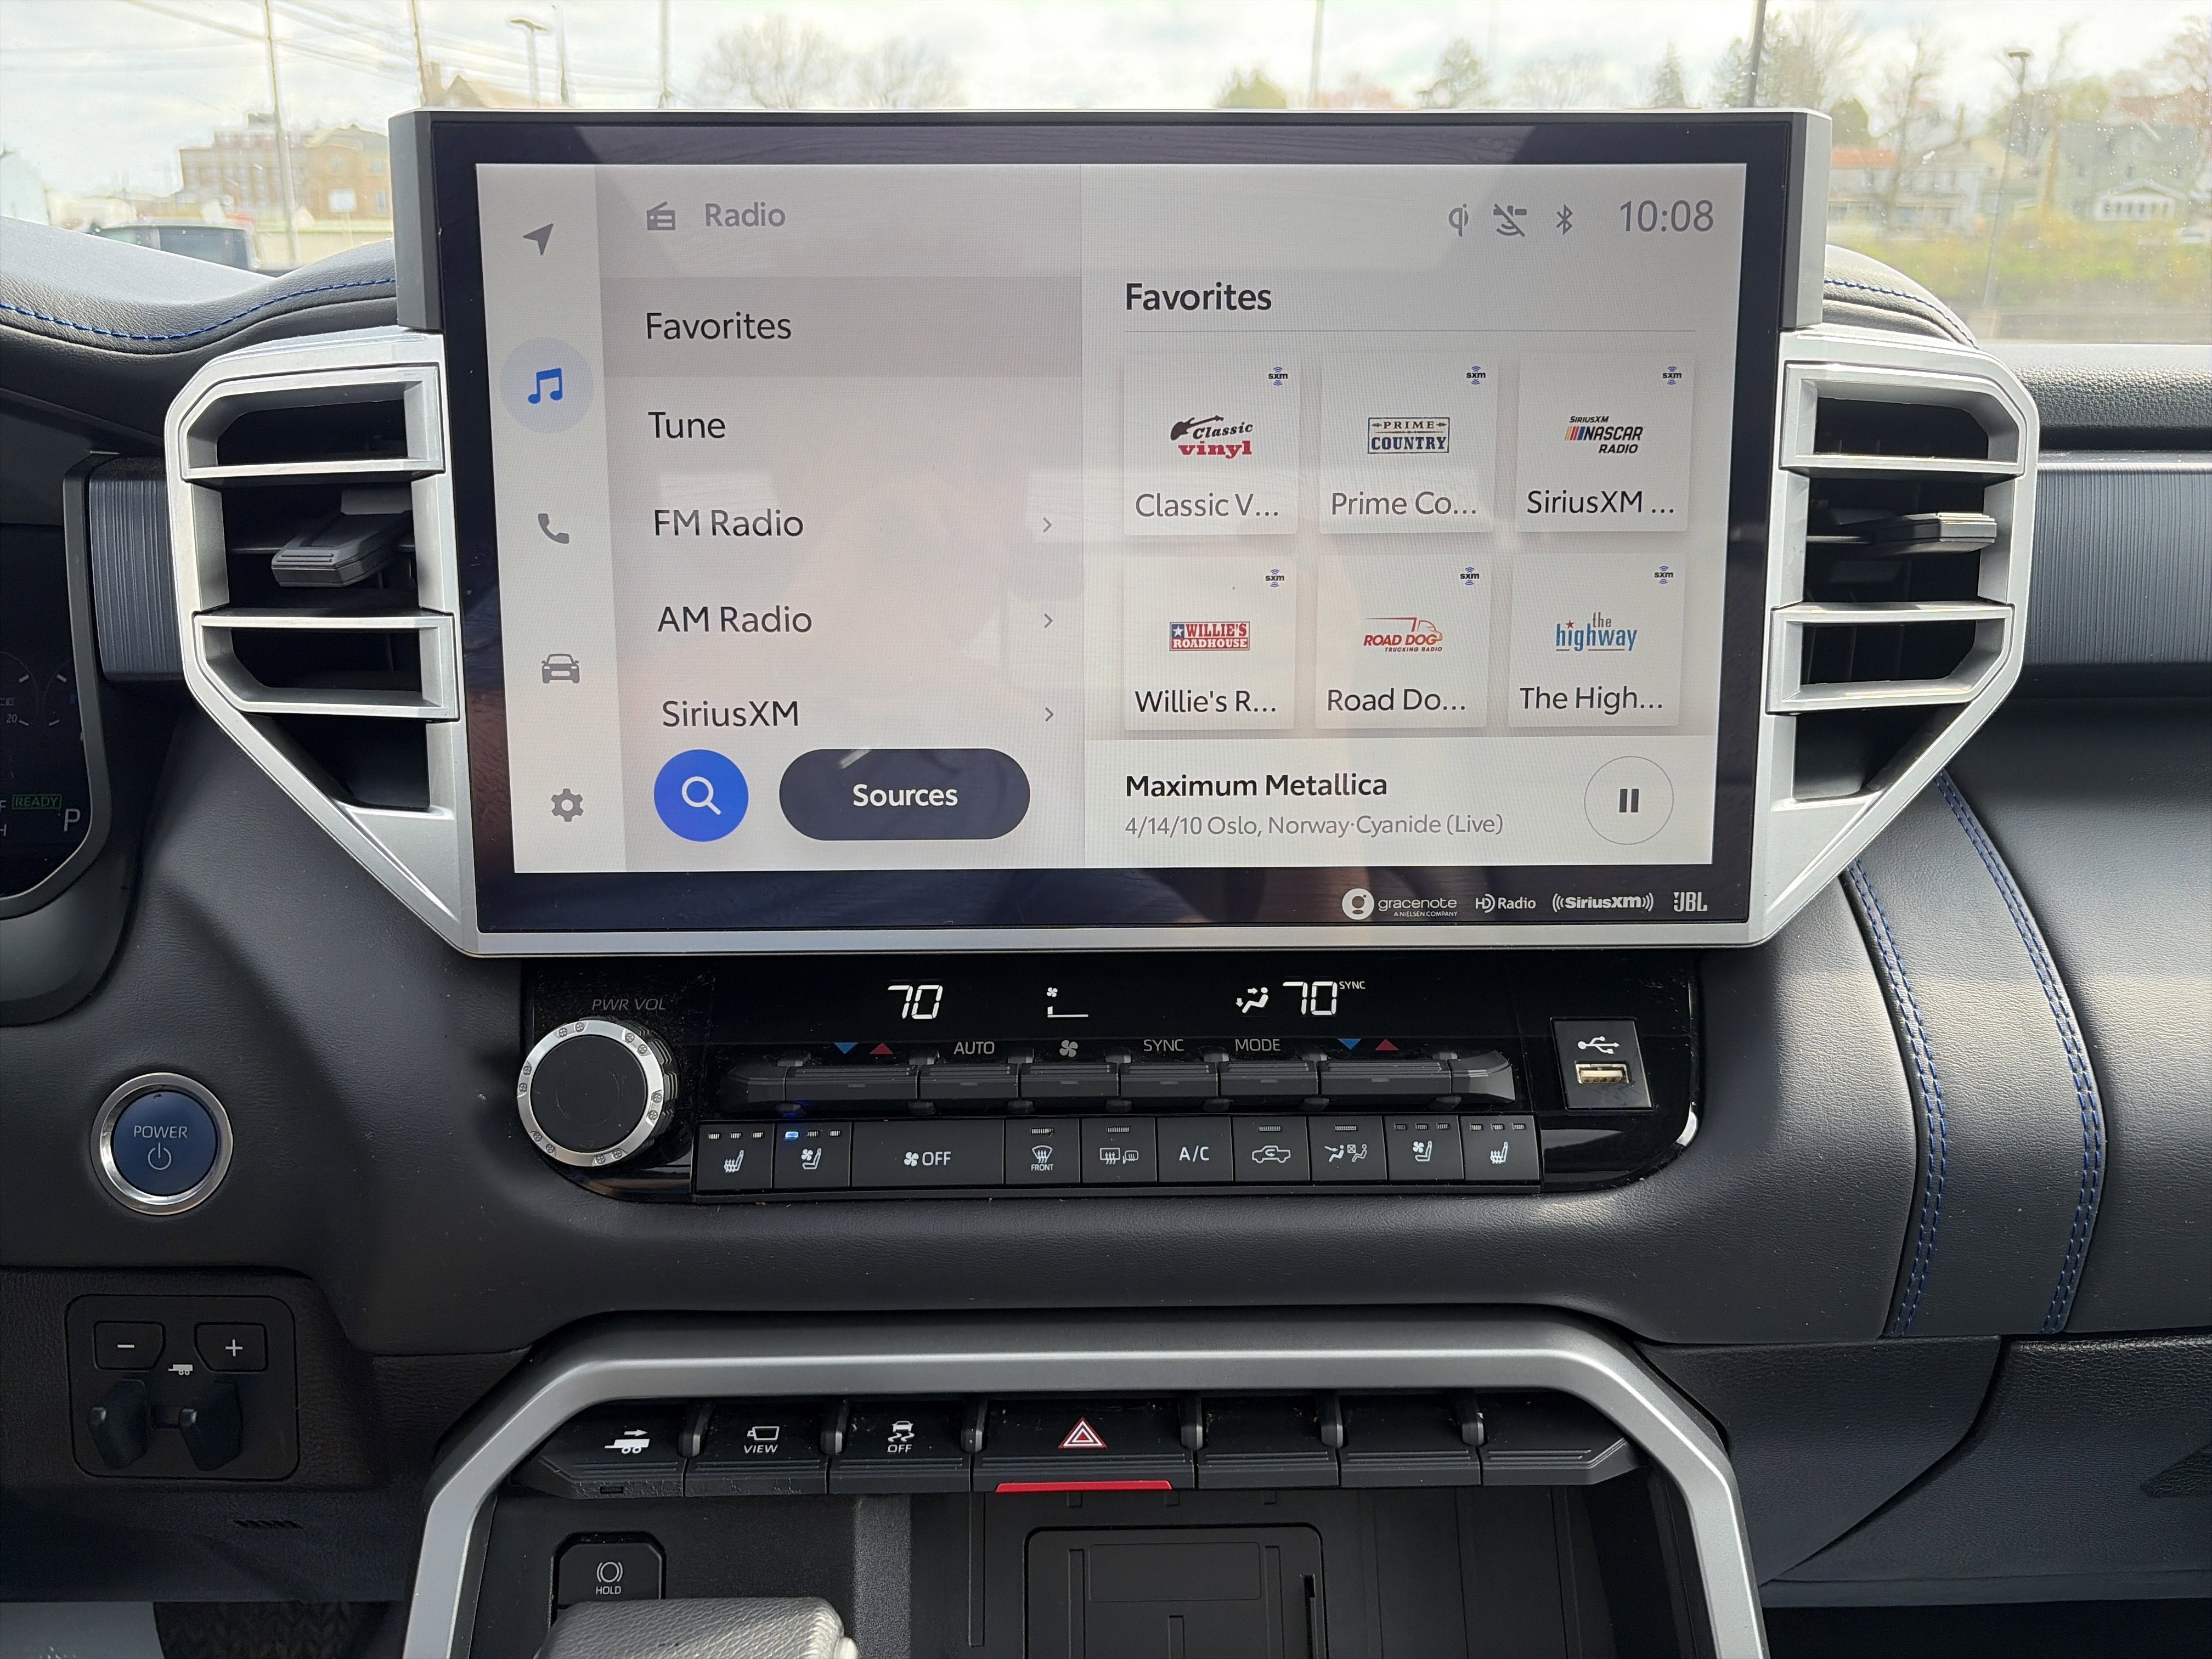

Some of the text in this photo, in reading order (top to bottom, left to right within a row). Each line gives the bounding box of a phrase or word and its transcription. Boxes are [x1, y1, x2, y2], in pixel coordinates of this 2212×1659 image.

[705, 201, 786, 227] Radio
[1620, 200, 1714, 232] 10:08
[1126, 281, 1272, 311] Favorites
[646, 311, 792, 340] Favorites
[647, 411, 726, 439] Tune
[1193, 421, 1253, 439] Classic
[1383, 420, 1435, 430] PRIME
[1583, 426, 1644, 441] NASCAR
[1178, 441, 1252, 459] vinyl
[1372, 436, 1447, 450] COUNTRY
[1598, 444, 1639, 454] RADIO
[1136, 492, 1278, 517] Classic V...
[1332, 491, 1476, 515] Prime Co...
[1527, 489, 1643, 514] SiriusXM
[654, 509, 803, 537] FM Radio
[657, 605, 812, 633] AM Radio
[1592, 611, 1612, 628] the
[1173, 639, 1247, 648] ROADHOUSE
[1363, 634, 1437, 646] ROAD DOG
[1556, 623, 1638, 651] highway
[1135, 689, 1276, 713] Willie's R...
[1328, 687, 1465, 712] Road Do...
[1519, 685, 1662, 715] The High...
[663, 700, 798, 727] SiriusXM
[853, 783, 958, 806] Sources
[1126, 772, 1387, 797] Maximum Metallica
[15, 796, 59, 807] READY
[64, 808, 81, 832] P
[1125, 816, 1202, 838] 4/14/10
[1207, 815, 1262, 837] Oslo,
[1447, 814, 1503, 836] (Live)
[1378, 898, 1458, 911] gracenote
[1475, 893, 1536, 913] HD Radio
[1673, 891, 1708, 912] JBL
[591, 998, 666, 1011] PWR VOL
[888, 984, 943, 1019] 70
[1282, 981, 1365, 1015] 70 SYNC
[953, 1041, 995, 1055] AUTO
[1143, 1039, 1184, 1052] SYNC
[1235, 1039, 1281, 1052] MODE
[134, 1125, 188, 1138] POWER
[922, 1151, 951, 1166] OFF
[1178, 1145, 1210, 1162] A/C
[1031, 1163, 1054, 1171] FRONT
[743, 1444, 778, 1453] VIEW
[887, 1444, 912, 1453] OFF
[595, 1585, 622, 1595] HOLD
